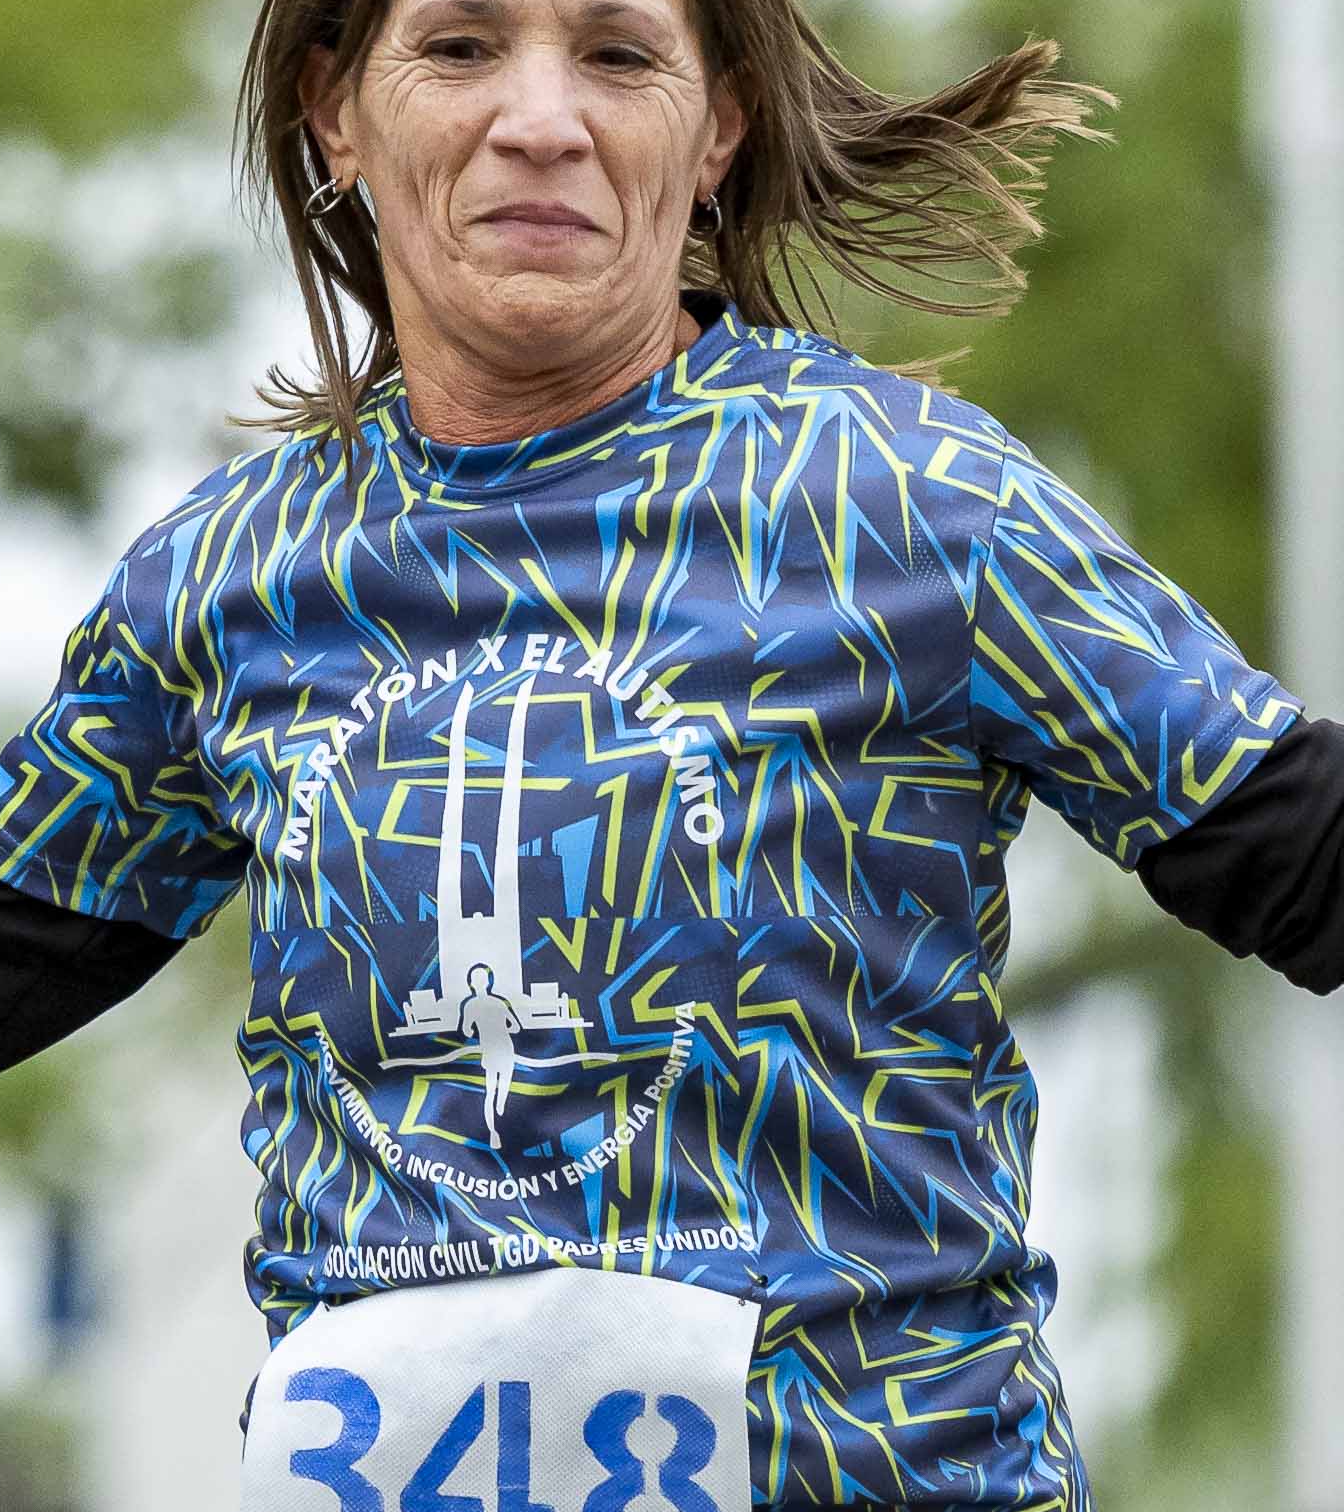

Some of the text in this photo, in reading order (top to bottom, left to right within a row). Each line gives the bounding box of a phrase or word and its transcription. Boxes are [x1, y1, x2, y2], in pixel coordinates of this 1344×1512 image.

[279, 633, 725, 862] MARATÓN X EL AUTISMO
[406, 1152, 540, 1200] INCLUSIÓN
[540, 1170, 560, 1192] Y
[565, 1100, 656, 1186] ENERGÍA
[643, 1000, 697, 1103] POSITIVA
[429, 1239, 489, 1277] CIVIL
[488, 1233, 540, 1270] TGD
[545, 1236, 650, 1260] PADRES
[655, 1225, 759, 1252] UNIDOS
